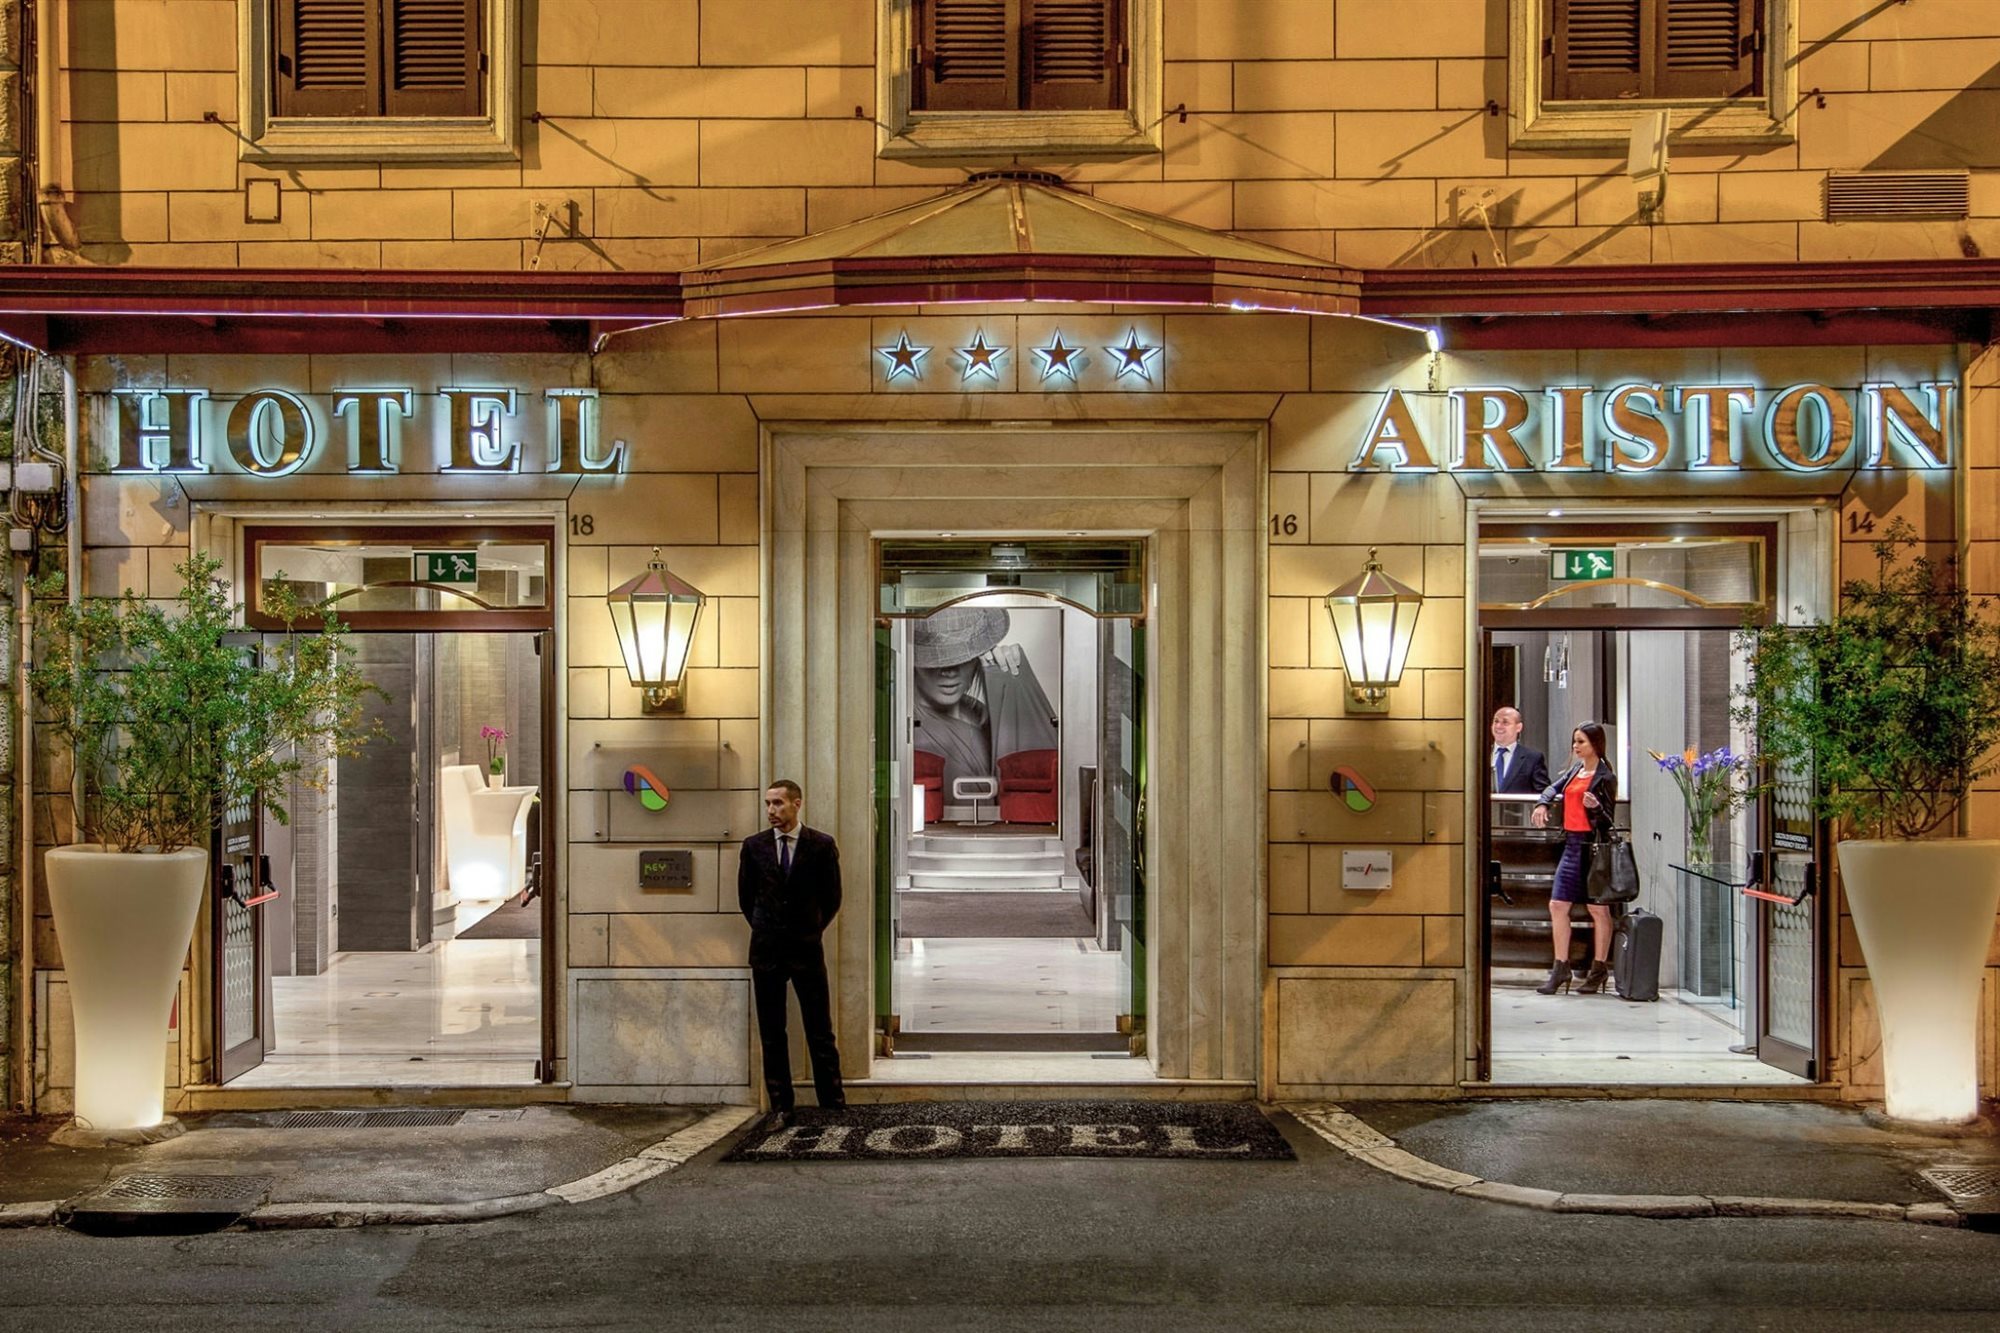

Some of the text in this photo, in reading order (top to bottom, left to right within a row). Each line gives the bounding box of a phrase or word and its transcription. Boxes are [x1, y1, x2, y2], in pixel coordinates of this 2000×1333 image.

[111, 387, 626, 477] HOTEL
[1347, 382, 1957, 473] ARISTON
[570, 514, 594, 536] 18
[1270, 513, 1297, 536] 16
[1847, 511, 1876, 534] 14
[745, 1124, 1250, 1154] HOTEL
